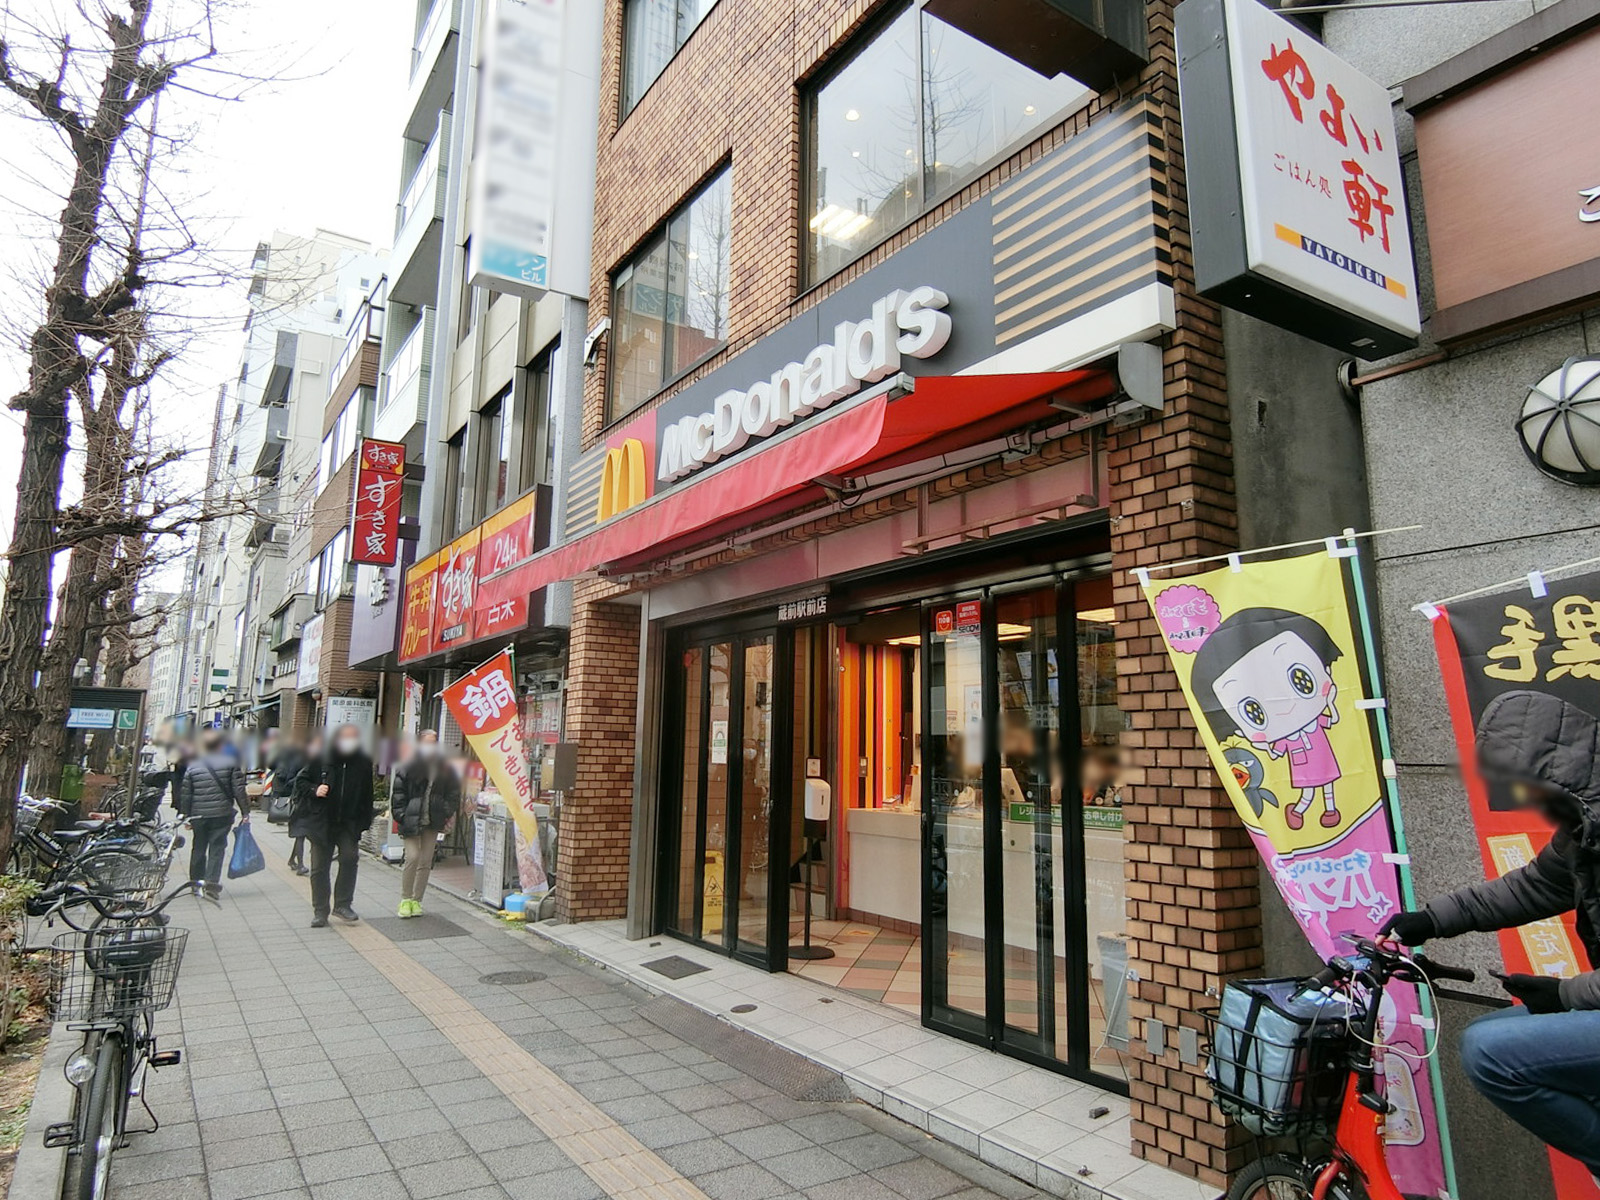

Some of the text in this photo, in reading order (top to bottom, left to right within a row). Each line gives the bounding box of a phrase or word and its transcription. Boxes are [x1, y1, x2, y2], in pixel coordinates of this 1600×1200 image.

[1274, 153, 1332, 198] ごはん処
[1302, 237, 1386, 288] YAYOIKEN
[657, 285, 952, 482] McDonald's
[364, 474, 397, 558] すき家
[409, 577, 432, 616] 牛丼
[441, 544, 476, 622] すき家
[442, 624, 464, 642] SUKIYA
[777, 597, 827, 622] 蔵前駅前店
[404, 619, 429, 657] カレー
[461, 669, 517, 728] 鍋
